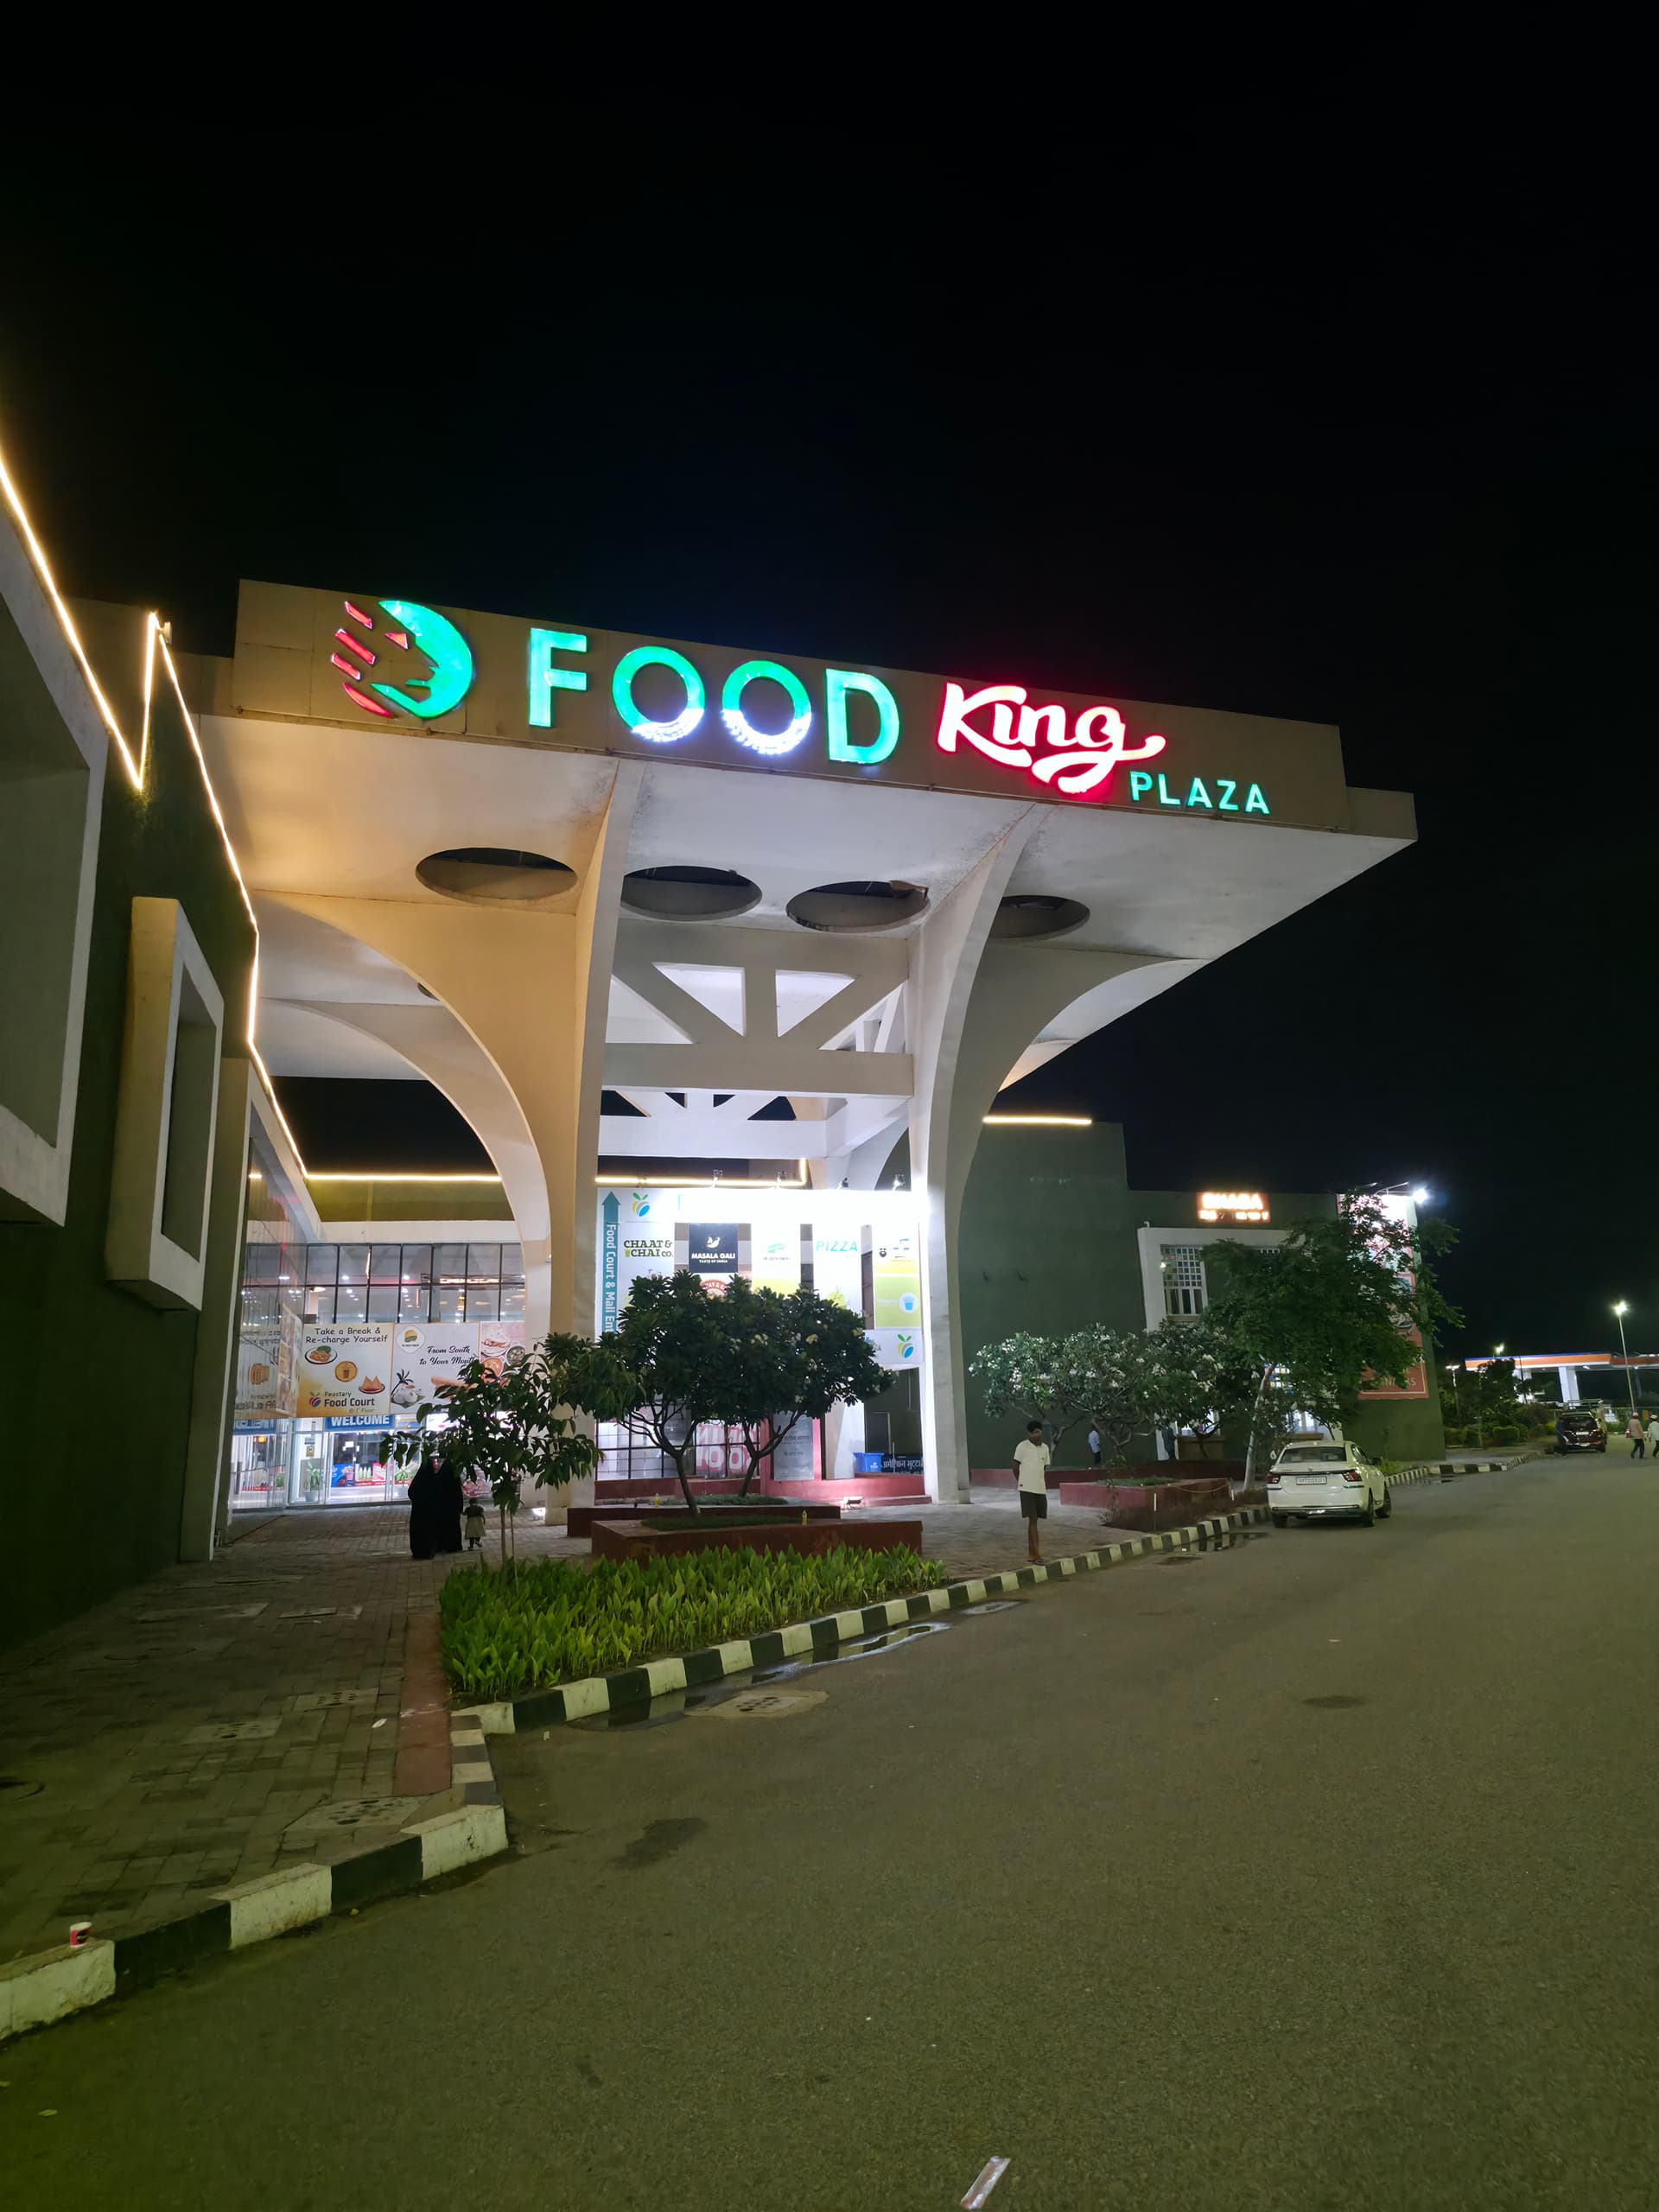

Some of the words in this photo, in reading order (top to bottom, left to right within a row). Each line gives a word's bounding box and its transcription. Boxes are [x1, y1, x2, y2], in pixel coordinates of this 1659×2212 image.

[529, 626, 900, 765] FOOD
[938, 683, 1166, 794] King
[1129, 772, 1271, 815] PLAZA
[606, 1224, 617, 1249] Food
[623, 1240, 664, 1249] CHAAT
[664, 1240, 673, 1249] &
[816, 1241, 858, 1252] PIZZA
[631, 1249, 661, 1257] CHAI
[606, 1252, 616, 1279] Court
[605, 1293, 616, 1313] Mall
[605, 1315, 615, 1332] Ent
[305, 1336, 350, 1345] Re-charge
[427, 1345, 447, 1354] From
[448, 1345, 470, 1354] South
[429, 1357, 448, 1365] Your
[324, 1398, 346, 1408] Food
[349, 1397, 375, 1407] Court
[331, 1414, 390, 1427] WELCOME
